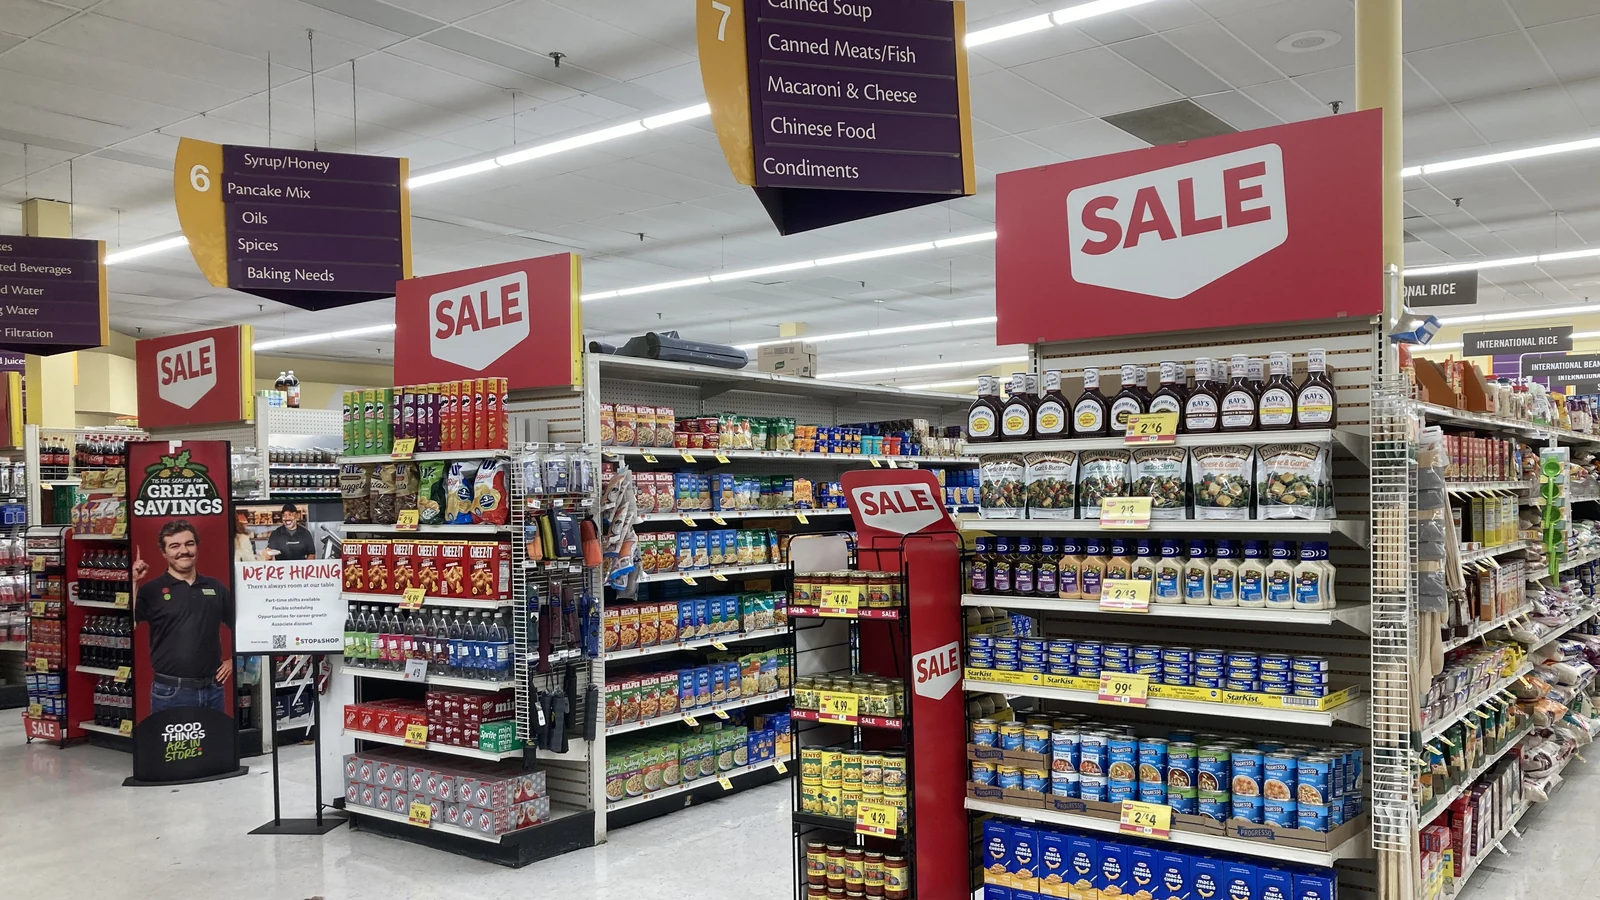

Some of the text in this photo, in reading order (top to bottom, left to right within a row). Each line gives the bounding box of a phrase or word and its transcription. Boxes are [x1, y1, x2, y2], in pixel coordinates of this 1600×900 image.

[833, 0, 872, 22] Soup
[712, 1, 731, 42] 7
[768, 34, 916, 63] Canned Meats/Fish
[768, 76, 917, 103] Macaroni & Cheese
[770, 116, 876, 140] Chinese Food
[244, 152, 330, 174] Syrup/Honey
[763, 157, 859, 179] Condiments
[190, 164, 211, 192] 6
[228, 181, 311, 200] Pancake Mix
[1080, 160, 1272, 256] SALE
[242, 210, 268, 226] Oils
[238, 237, 279, 254] Spices
[20, 262, 72, 276] Beverages
[248, 266, 334, 284] Baking Needs
[11, 286, 44, 296] Water
[1430, 283, 1456, 295] RICE
[6, 305, 40, 316] Water
[435, 282, 522, 340] SALE
[4, 328, 54, 338] Filtration
[1476, 336, 1558, 349] INTERNATIONAL RICE
[160, 345, 213, 386] SALE
[1532, 362, 1582, 370] INTERNATIONAL
[147, 484, 208, 498] GREAT
[134, 498, 222, 516] SAVINGS
[860, 490, 935, 516] SALE
[242, 564, 341, 580] WE'RE HIRING
[916, 648, 958, 684] SALE
[967, 669, 992, 678] StarKist
[1047, 676, 1074, 685] StarKist
[1114, 682, 1132, 694] 99¢
[1226, 693, 1258, 702] StarKist
[31, 721, 55, 737] SALE
[161, 729, 206, 742] THINGS
[165, 722, 202, 734] GOOD
[480, 730, 497, 740] Sprite
[166, 738, 201, 751] ARE IN
[164, 748, 198, 762] STORE
[1240, 829, 1272, 837] PROGRESSO
